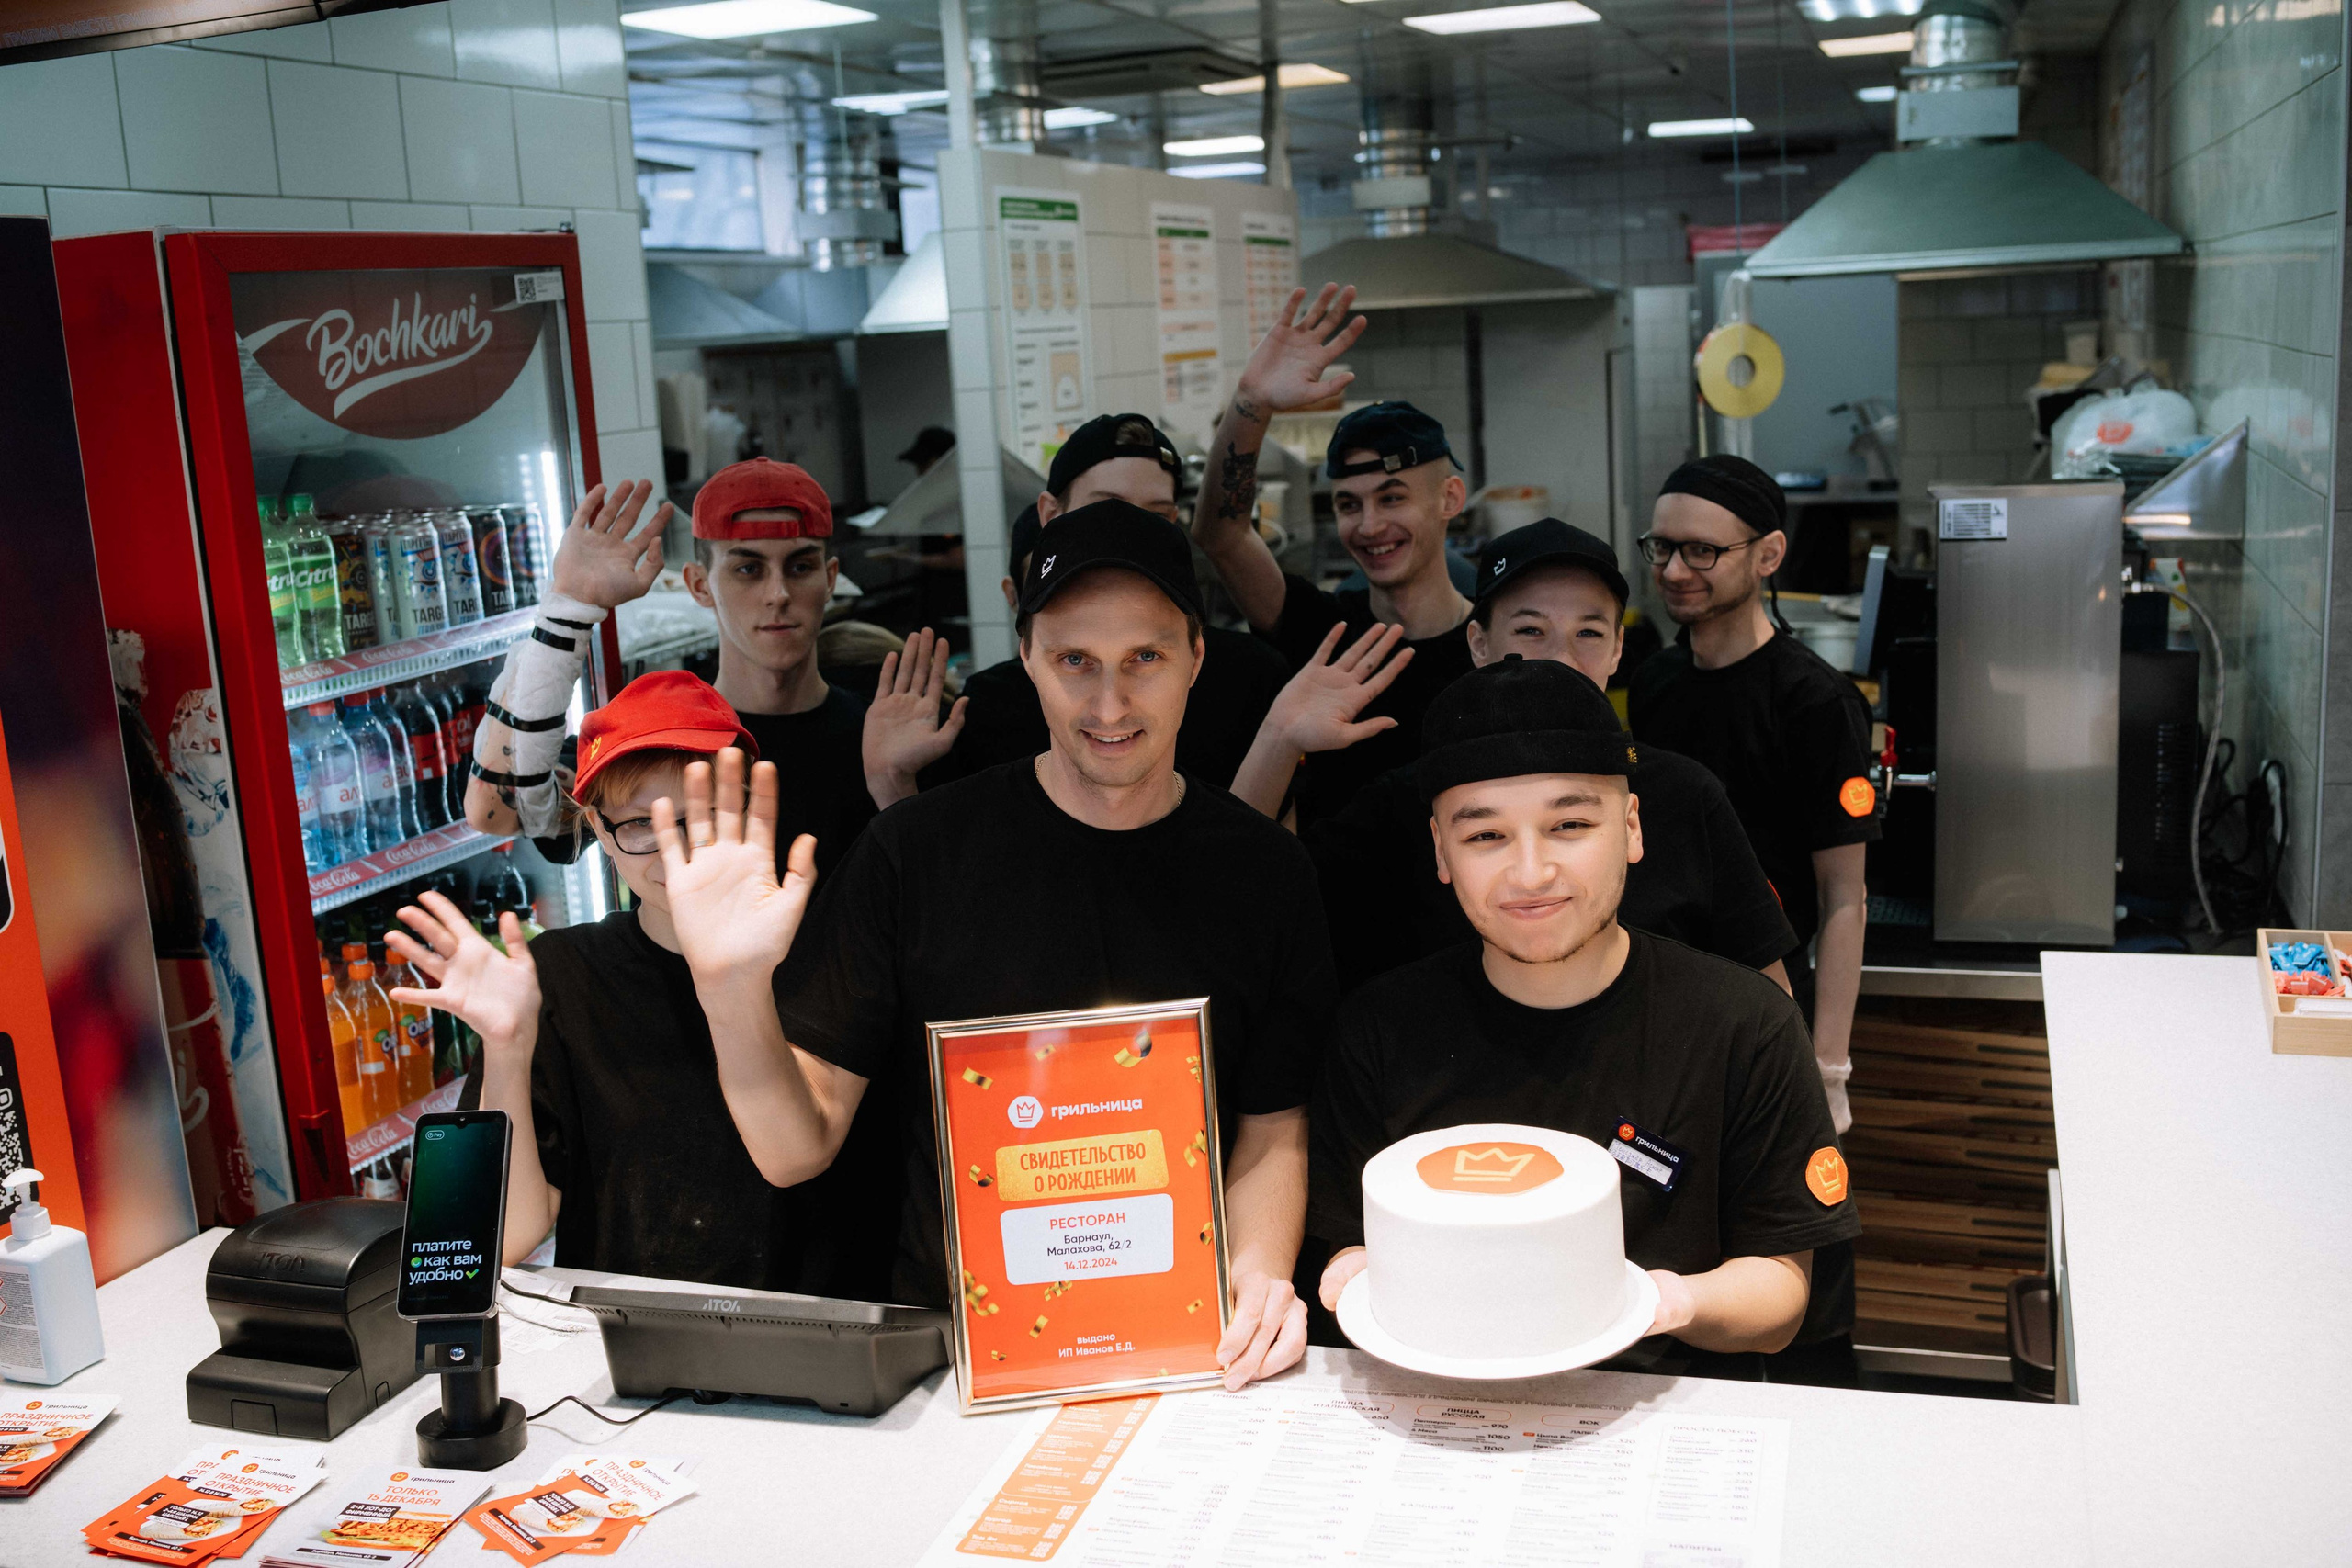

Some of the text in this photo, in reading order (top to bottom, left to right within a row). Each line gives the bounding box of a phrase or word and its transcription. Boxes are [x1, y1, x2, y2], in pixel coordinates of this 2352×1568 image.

[305, 291, 493, 391] Bochkari
[1050, 1098, 1144, 1120] грильница
[1020, 1142, 1147, 1171] СВИДЕТЕЛЬСТВО
[1634, 1135, 1680, 1163] грильница
[1034, 1167, 1136, 1193] О РОЖДЕНИИ
[1049, 1213, 1126, 1230] РЕСТОРАН
[412, 1240, 472, 1253] платите
[1046, 1237, 1132, 1257] Малахова, 62/2
[1064, 1233, 1114, 1245] Барнаул,
[424, 1253, 481, 1267] как вам
[1063, 1257, 1118, 1270] 14.12.2024
[409, 1266, 464, 1285] удобно
[1076, 1334, 1116, 1345] выдано
[1058, 1341, 1136, 1358] ИП Иванов Е.Д.
[2, 1412, 94, 1420] ПРАЗДНИЧНОЕ
[1440, 1412, 1486, 1420] РУССКАЯ
[258, 1469, 297, 1480] грильница
[410, 1476, 456, 1484] грильница
[604, 1461, 665, 1501] ПРАЗДНИЧНОЕ
[205, 1480, 265, 1496] ОТКРЫТИЕ
[214, 1472, 297, 1495] ПРАЗДНИЧНОЕ
[385, 1485, 439, 1496] ТОЛЬКО
[592, 1468, 637, 1498] ОТКРЫТИЕ
[367, 1493, 442, 1506] 15 ДЕКАБРЯ
[345, 1509, 392, 1518] ФИРМЕННЫЙ
